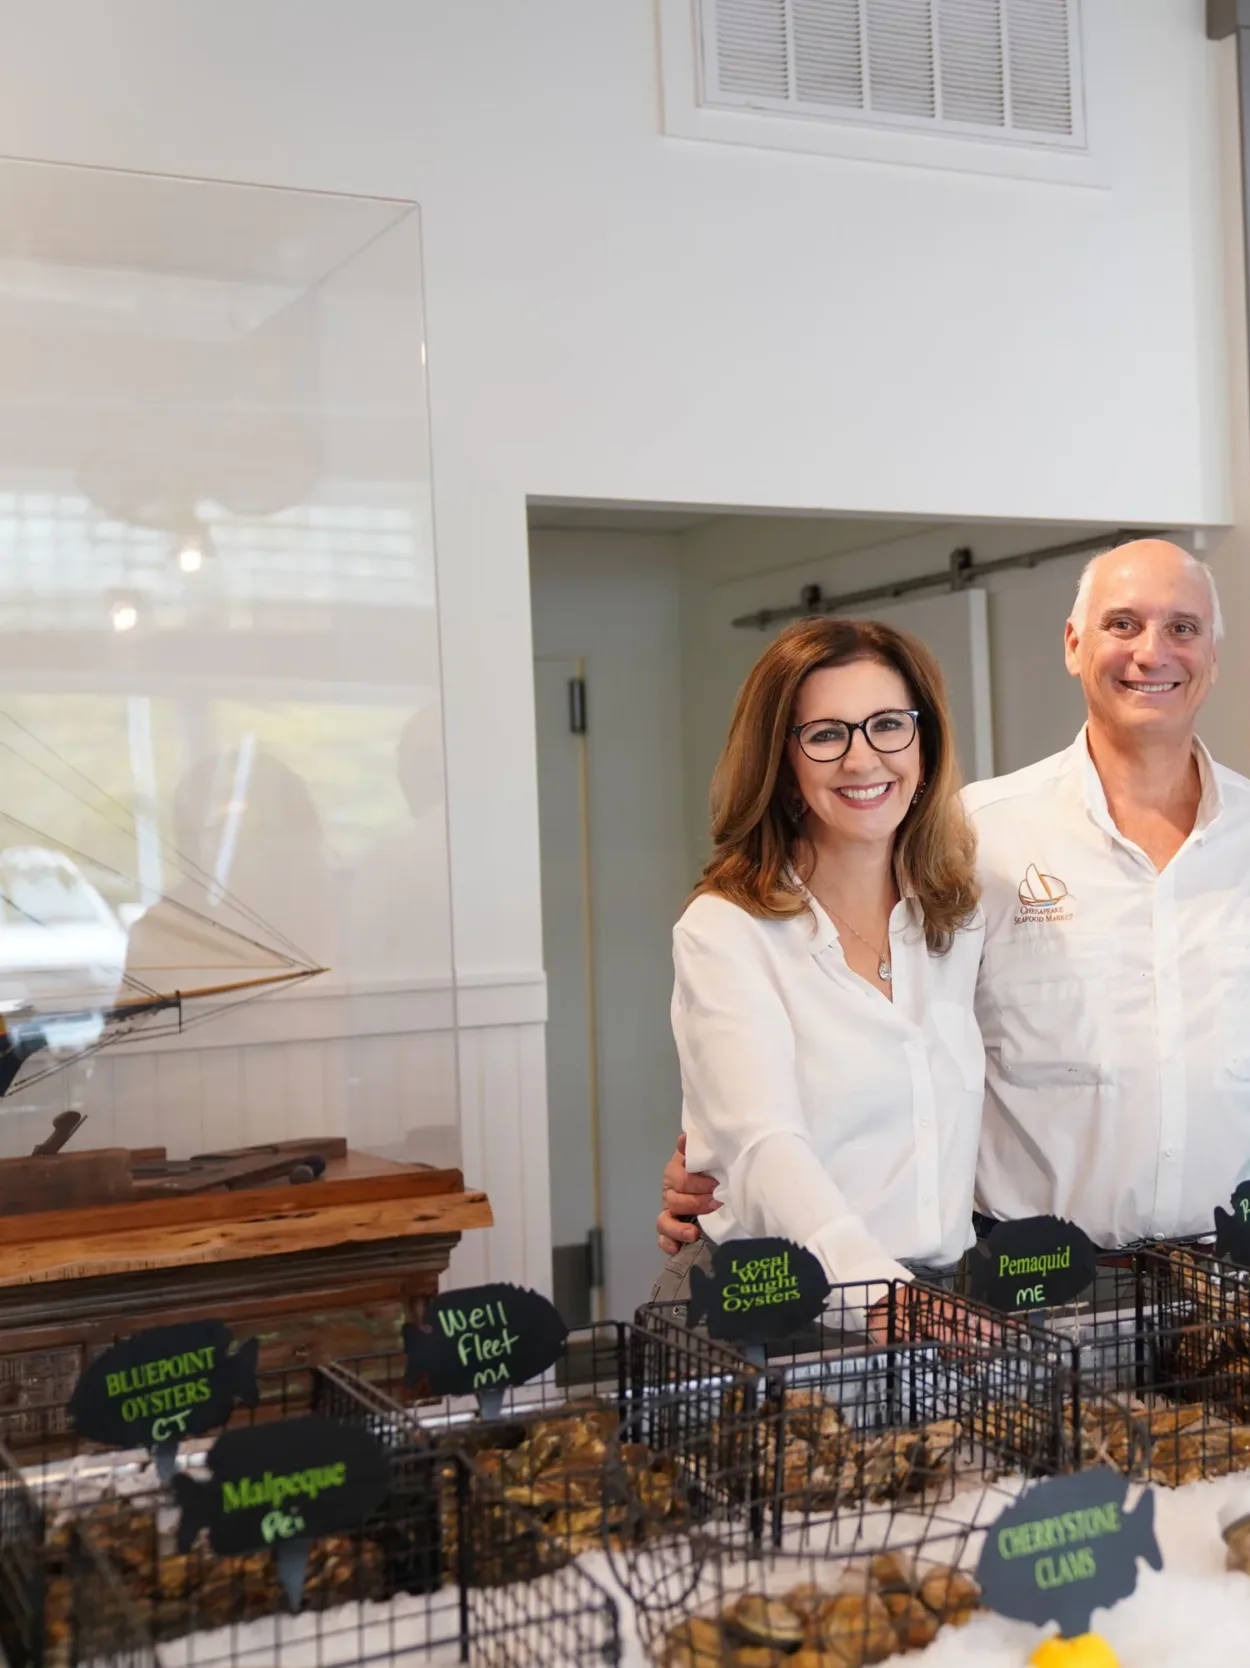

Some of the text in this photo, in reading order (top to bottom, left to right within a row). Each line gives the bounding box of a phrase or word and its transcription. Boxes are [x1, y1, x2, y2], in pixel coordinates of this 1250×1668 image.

[731, 1251, 789, 1273] Local
[737, 1262, 789, 1283] Wild
[999, 1245, 1070, 1277] Pemaquid
[722, 1275, 798, 1298] Caught
[722, 1289, 801, 1312] Oysters
[1016, 1284, 1045, 1306] ME
[438, 1301, 508, 1337] Well
[458, 1328, 520, 1366] Fleet
[105, 1346, 216, 1397] BLUEPOINT
[121, 1378, 211, 1422] OYSTERS
[152, 1409, 192, 1441] CT
[222, 1461, 347, 1513] Malpeque
[998, 1501, 1121, 1560] CHERRYSTONE
[1035, 1547, 1096, 1590] CLAMS
